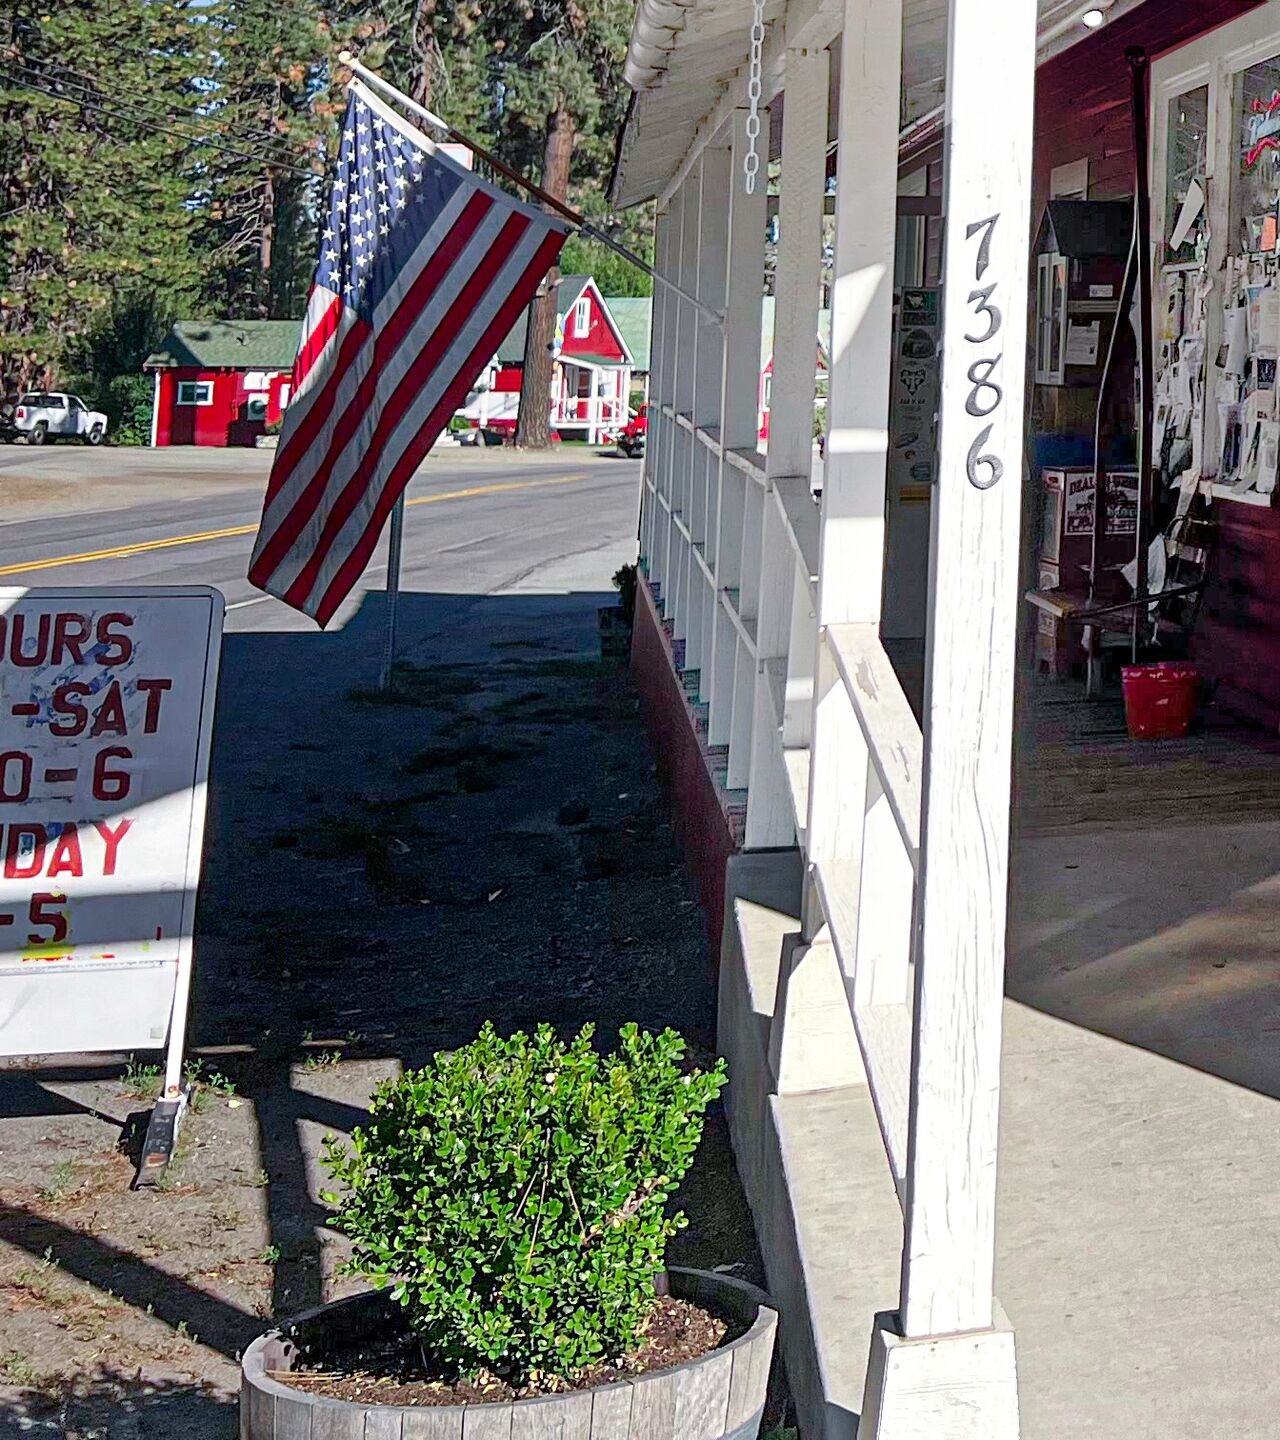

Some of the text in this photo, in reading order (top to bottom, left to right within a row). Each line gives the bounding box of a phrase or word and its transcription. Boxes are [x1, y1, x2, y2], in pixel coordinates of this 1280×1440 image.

[964, 212, 1004, 491] 7386
[0, 613, 135, 668] URS
[0, 818, 134, 879] DAY
